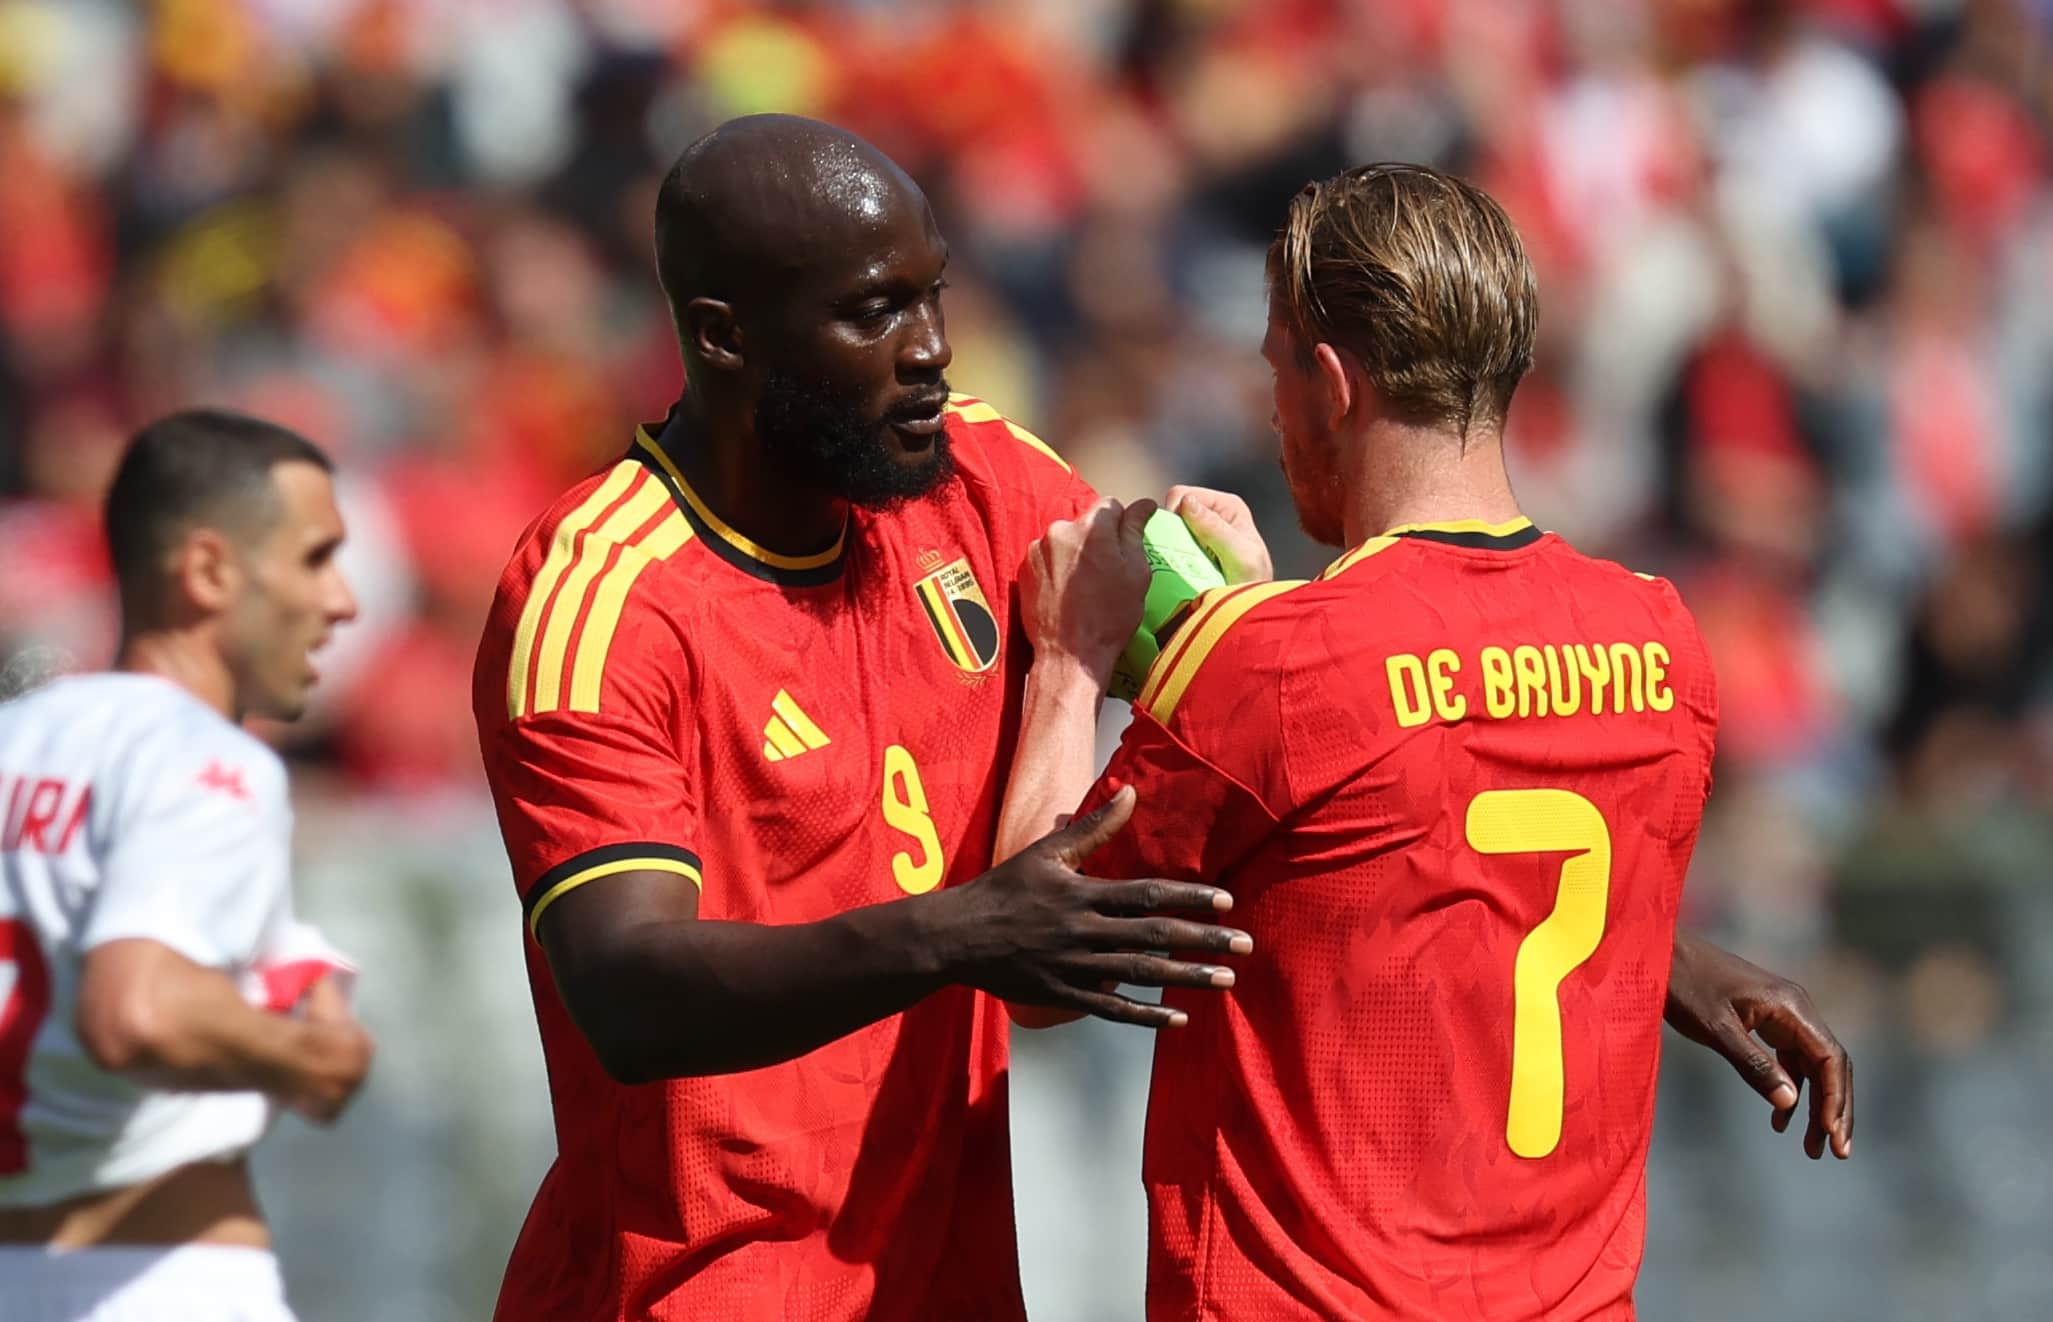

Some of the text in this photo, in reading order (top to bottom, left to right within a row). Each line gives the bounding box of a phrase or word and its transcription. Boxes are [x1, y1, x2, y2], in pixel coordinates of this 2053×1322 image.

[1387, 643, 1673, 726] DE BRUYNE
[883, 746, 943, 895] 9
[1467, 790, 1611, 1157] 7
